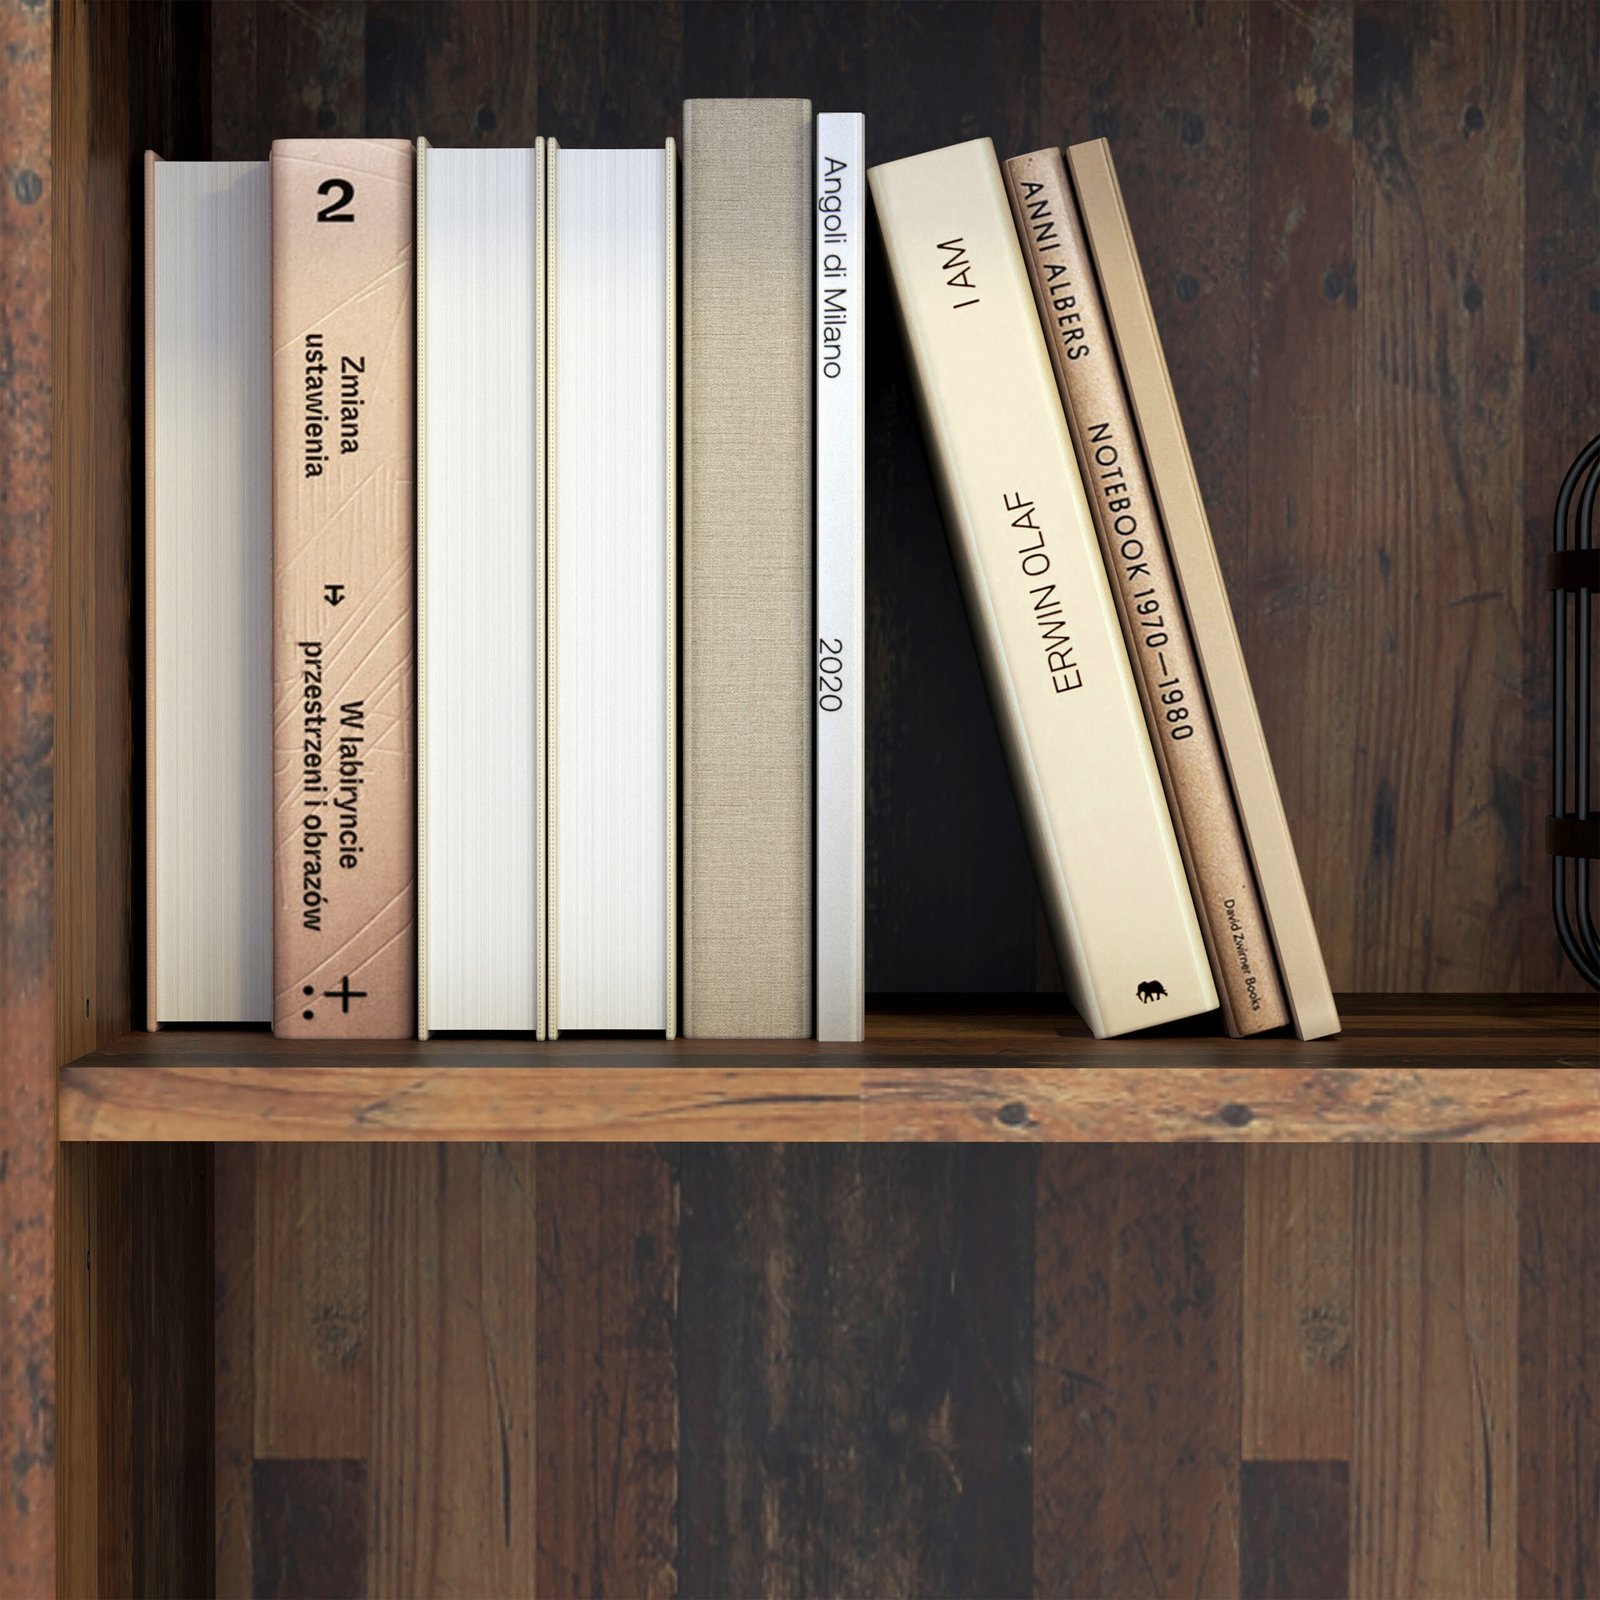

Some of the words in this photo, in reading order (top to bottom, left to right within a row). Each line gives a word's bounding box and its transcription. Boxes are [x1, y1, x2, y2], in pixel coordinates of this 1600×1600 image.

[316, 178, 355, 223] 2
[819, 156, 847, 244] Angoli
[823, 254, 847, 278] di
[936, 237, 976, 288] AM
[1020, 181, 1060, 252] ANNI
[1043, 263, 1090, 361] ALBERS
[823, 288, 847, 379] Milano
[304, 332, 330, 479] ustawienia
[340, 355, 366, 454] Zmiana
[1003, 491, 1051, 577] OLAF
[1088, 422, 1150, 581] NOTEBOOK
[819, 638, 843, 712] 2020
[1029, 583, 1083, 694] ERWIN
[298, 641, 327, 792] przestrzeni
[339, 700, 364, 730] W
[334, 736, 364, 870] labiryncie
[303, 815, 328, 932] obrazów
[1224, 899, 1242, 931] David
[1233, 932, 1250, 974] Zwirner
[1245, 977, 1260, 1011] Books
